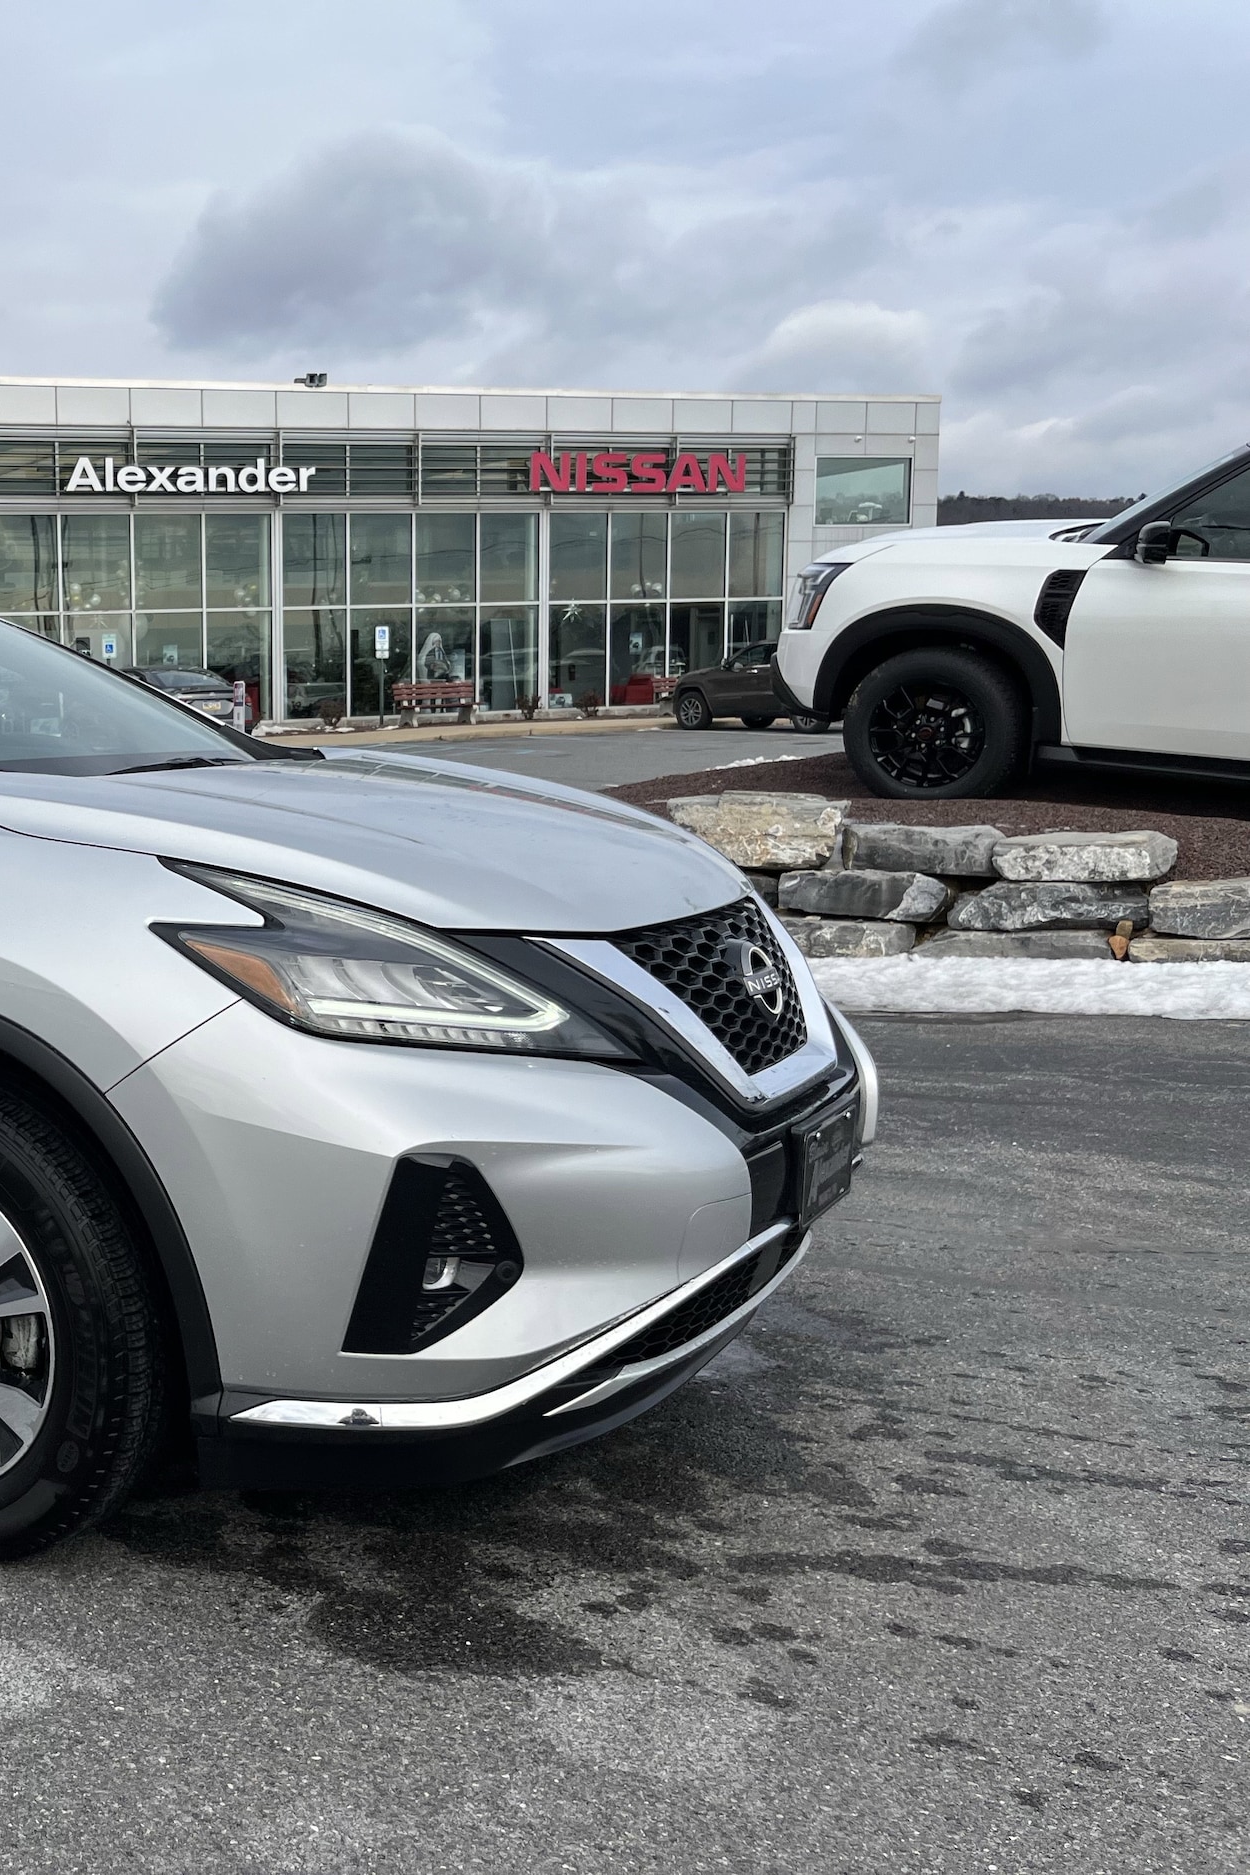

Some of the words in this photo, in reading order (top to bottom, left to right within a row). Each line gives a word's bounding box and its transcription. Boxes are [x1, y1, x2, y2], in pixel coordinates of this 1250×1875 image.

[65, 457, 316, 493] Alexander
[529, 451, 746, 493] NISSAN
[747, 973, 781, 993] NISS
